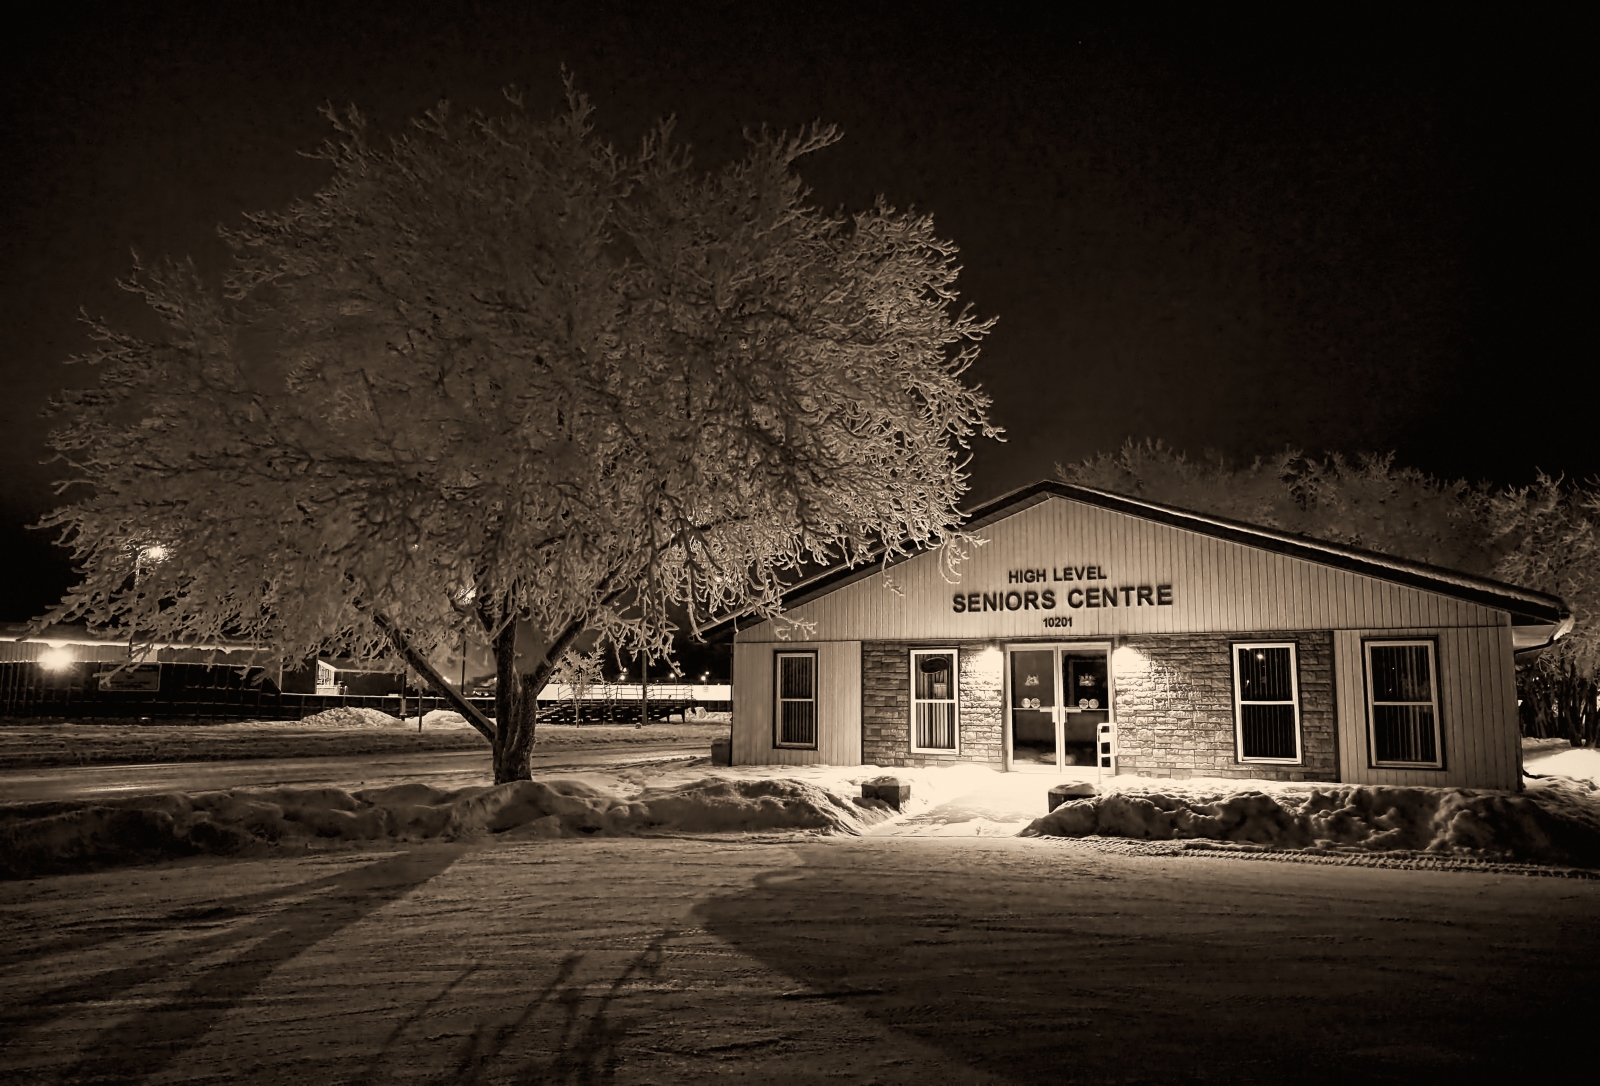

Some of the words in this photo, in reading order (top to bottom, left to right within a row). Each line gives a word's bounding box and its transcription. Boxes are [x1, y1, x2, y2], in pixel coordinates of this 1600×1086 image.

[1008, 568, 1047, 583] HIGH
[1053, 566, 1107, 582] LEVEL
[952, 590, 1057, 613] SENIORS
[1067, 585, 1173, 609] CENTRE
[1042, 617, 1073, 628] 10201
